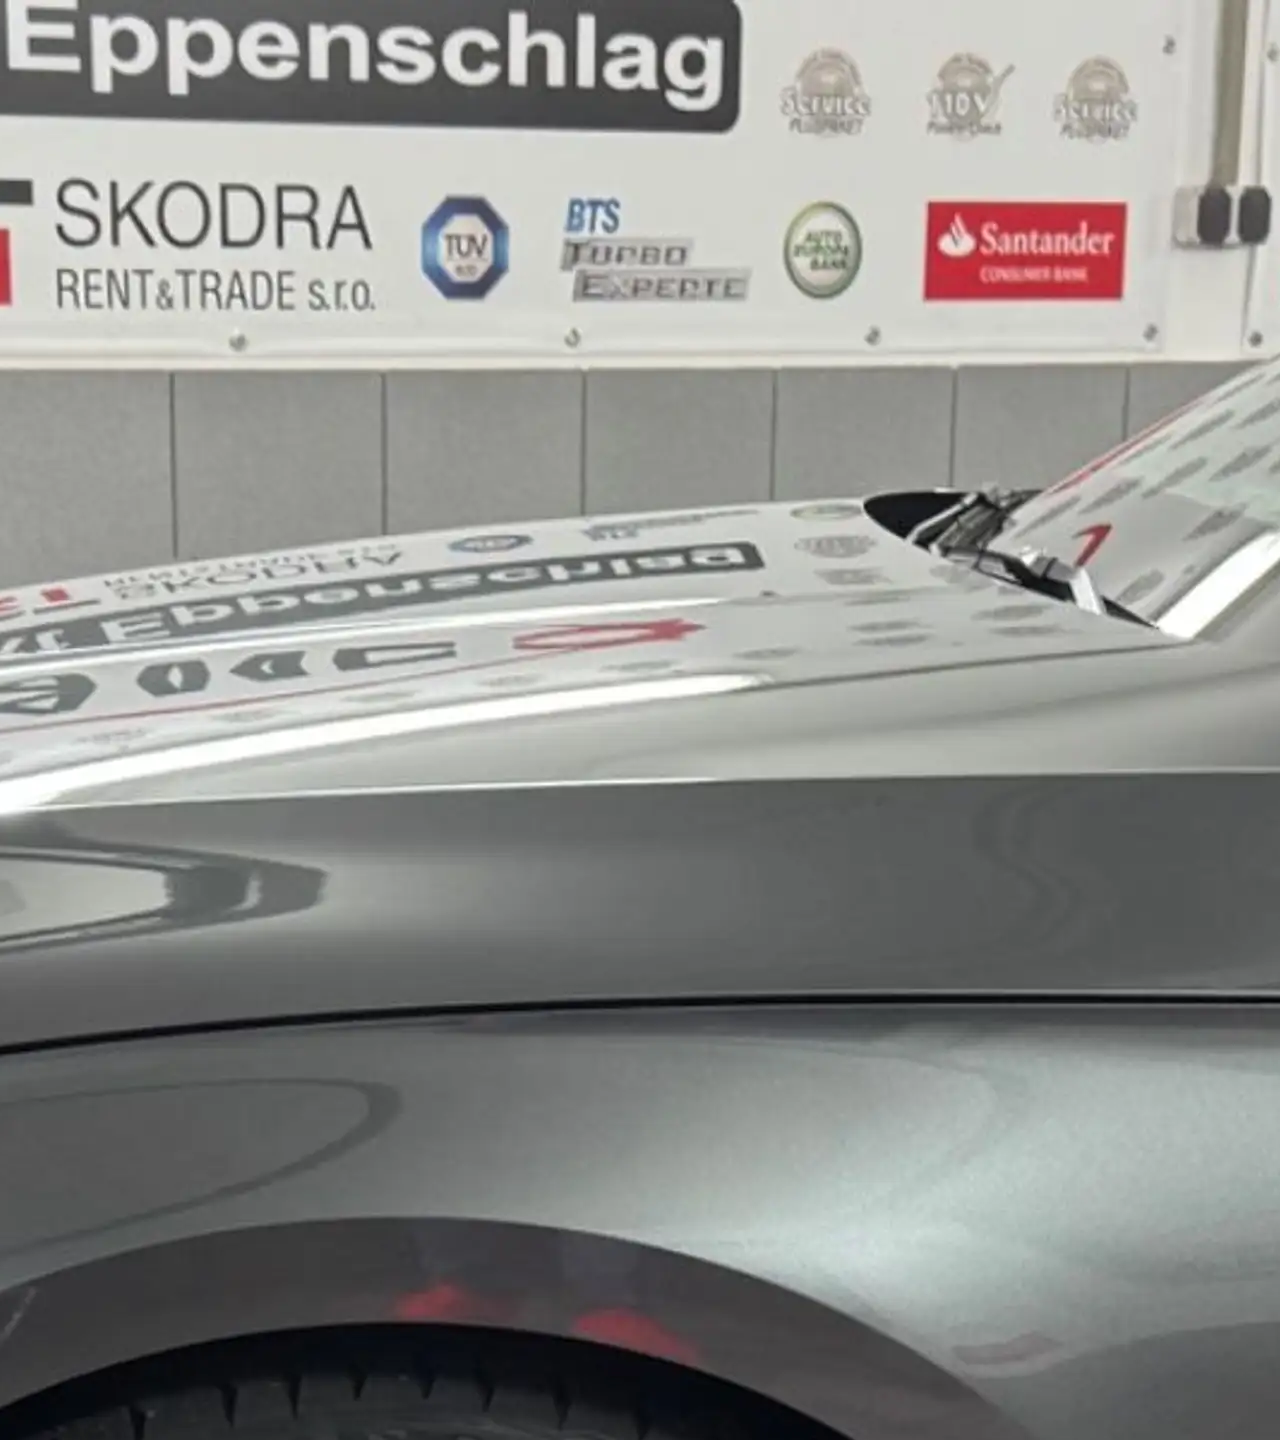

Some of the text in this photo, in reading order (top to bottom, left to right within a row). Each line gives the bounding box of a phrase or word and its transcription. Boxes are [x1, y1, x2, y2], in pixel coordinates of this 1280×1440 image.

[7, 0, 724, 112] Eppenschlag
[56, 179, 373, 250] SKODRA
[565, 198, 620, 233] BTS
[980, 219, 1115, 257] Santander
[56, 268, 376, 311] RENT&TRADE s.r.o.
